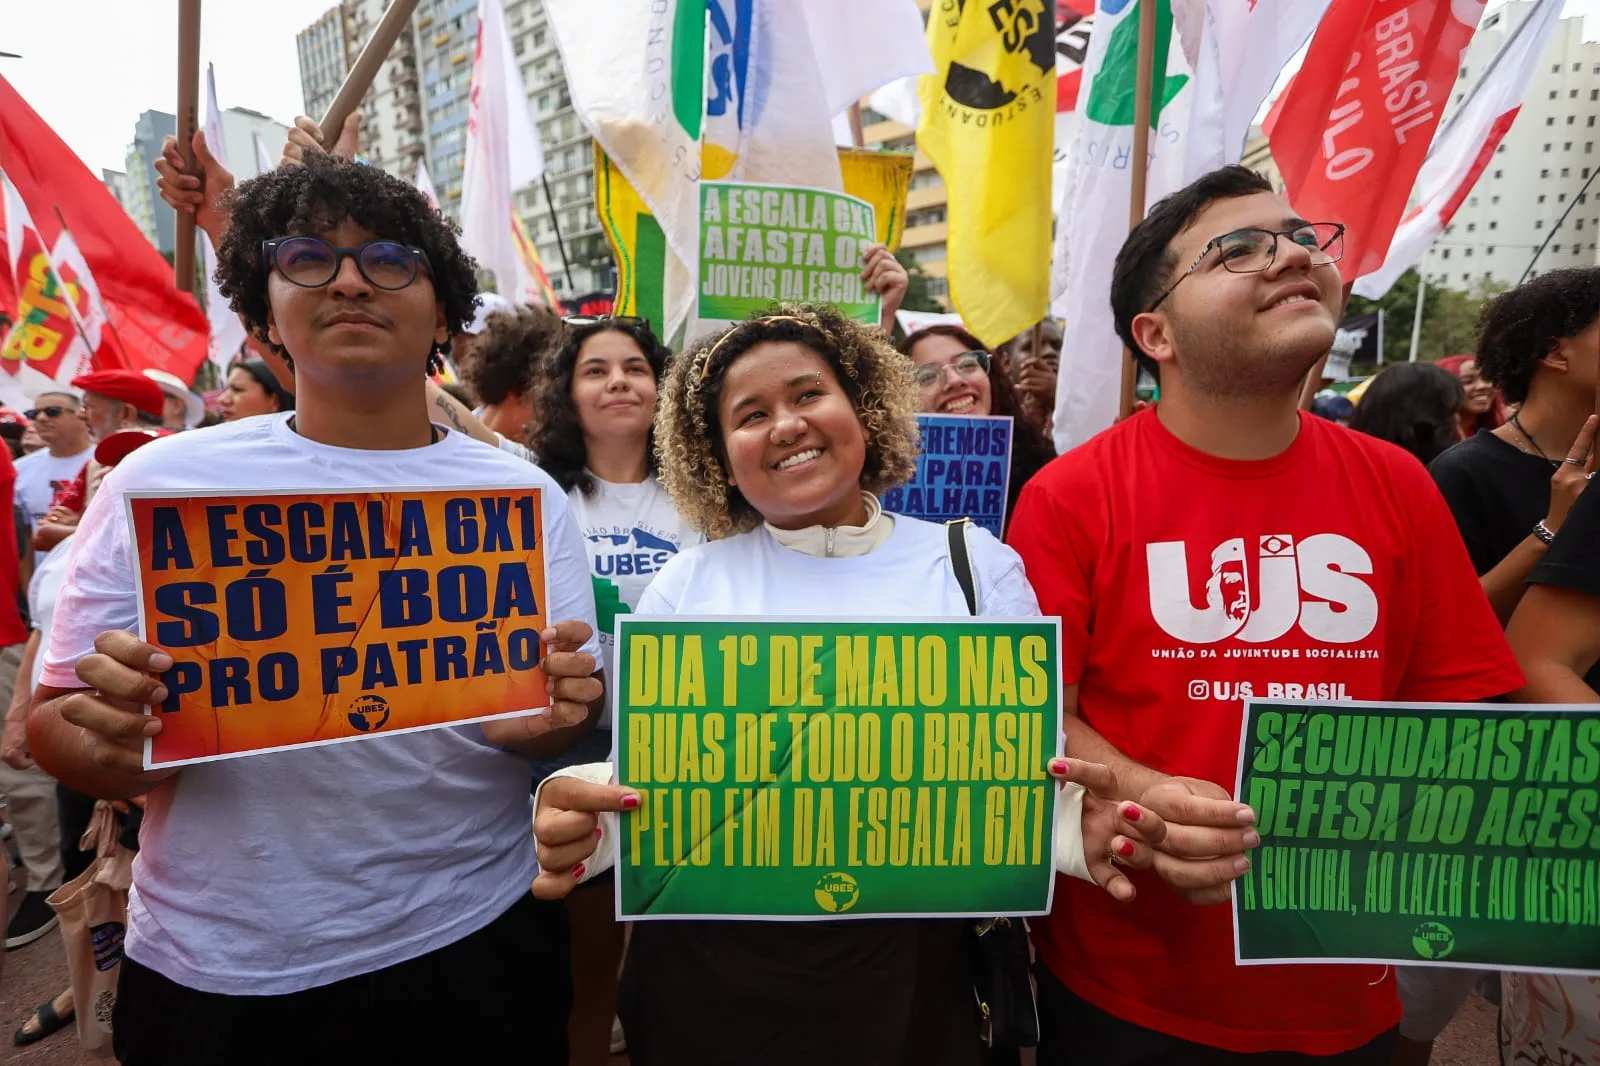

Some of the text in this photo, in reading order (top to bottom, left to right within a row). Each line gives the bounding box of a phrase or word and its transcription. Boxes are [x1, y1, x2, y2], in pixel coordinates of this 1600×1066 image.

[1375, 8, 1434, 145] BRASIL
[704, 188, 875, 240] A ESCALA 6X1
[704, 226, 826, 266] AFASTA
[703, 264, 776, 299] JOVENS
[780, 269, 803, 300] DA
[884, 487, 1001, 514] BALHAR
[927, 459, 1002, 486] PARA
[152, 496, 536, 571] A ESCALA 6X1
[155, 562, 538, 648] SÓ É BOA
[1146, 533, 1379, 644] UJS
[160, 620, 540, 713] PRO PATRÃO
[629, 634, 706, 707] DIA
[769, 635, 823, 707] DE
[835, 635, 947, 707] MAIO
[959, 635, 1048, 707] NAS
[1151, 647, 1379, 659] UNIÃO DA JUVENTUDE SOCIALISTA
[357, 704, 384, 713] UBES
[628, 712, 1047, 783] RUAS DE TODO O BRASIL
[1252, 711, 1600, 784] SECUNDARISTAS
[630, 785, 1045, 867] PELO FIM DA ESCALA 6X1
[1250, 777, 1400, 842] DEFESA
[1407, 784, 1475, 845] DO
[824, 883, 854, 893] UBES
[1261, 847, 1357, 916] CULTURA,
[1364, 851, 1395, 913] AO
[1399, 853, 1466, 917] LAZER
[1470, 855, 1484, 919] E
[1487, 856, 1519, 920] AO
[1524, 857, 1600, 926] DESCA
